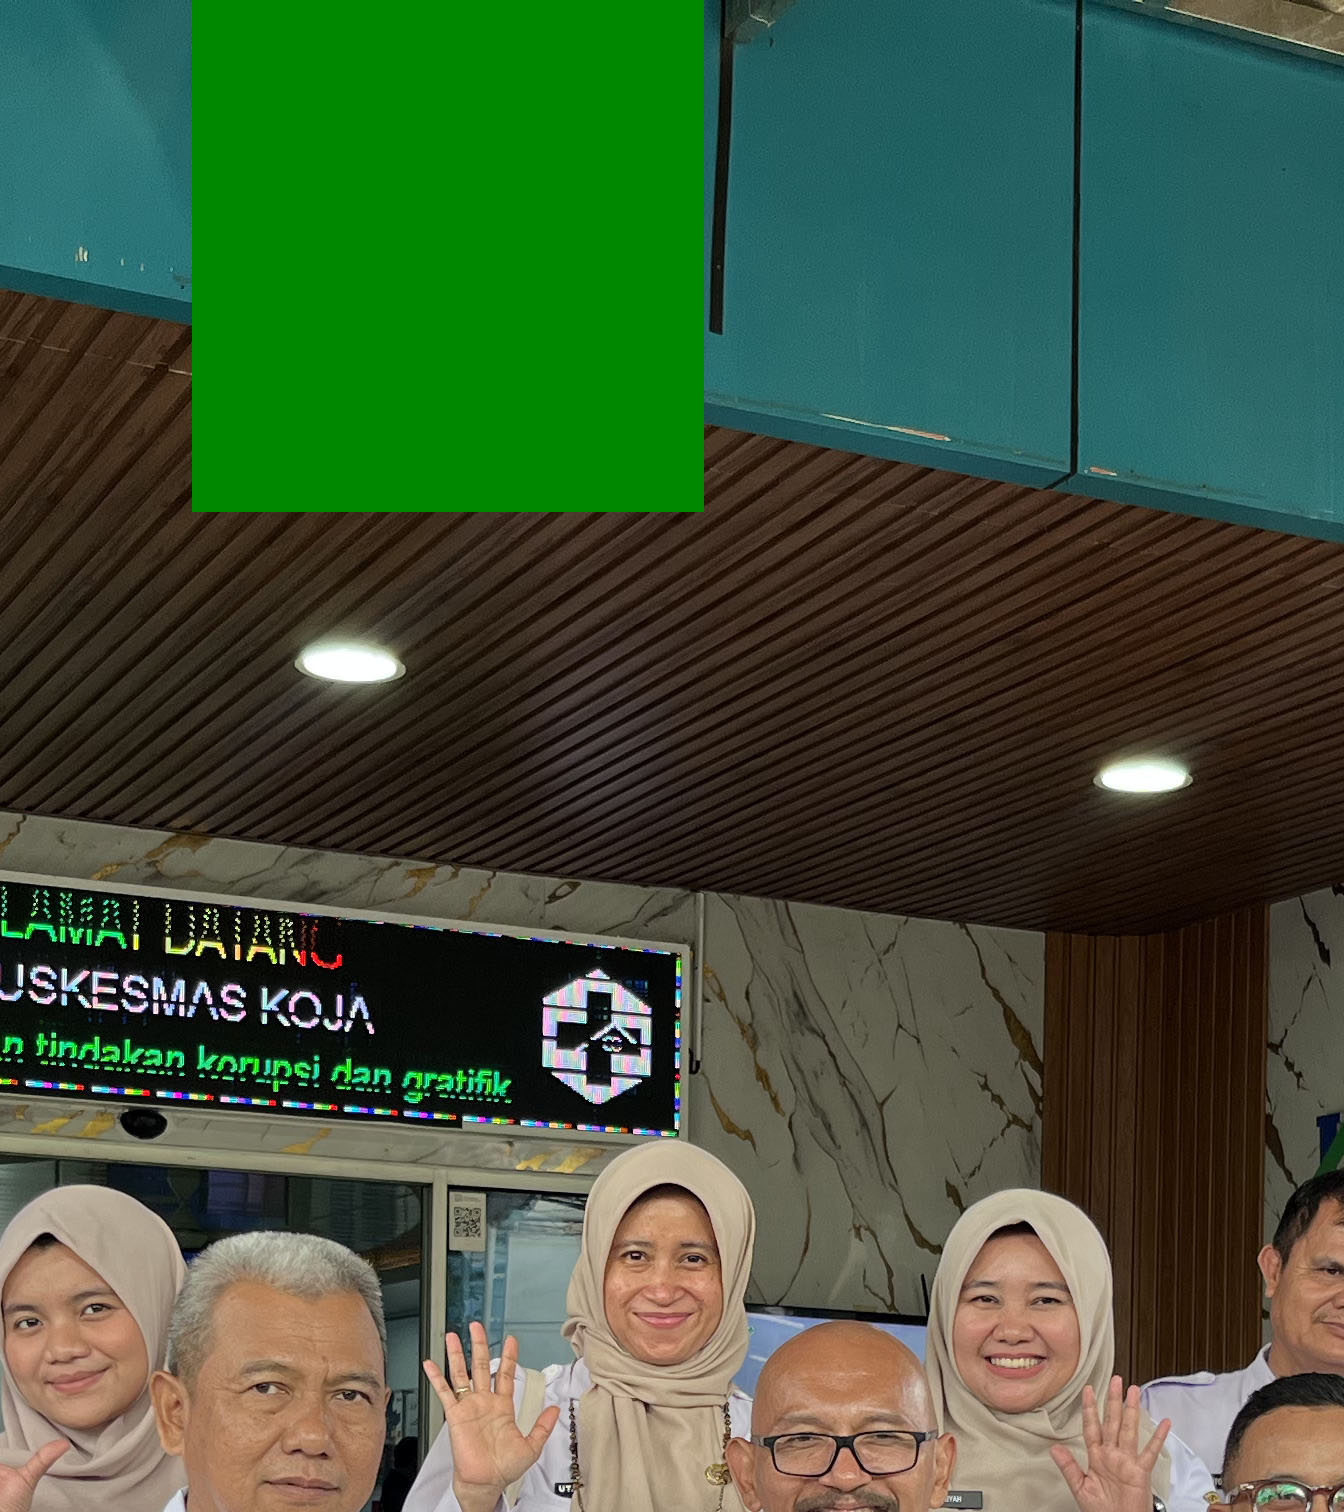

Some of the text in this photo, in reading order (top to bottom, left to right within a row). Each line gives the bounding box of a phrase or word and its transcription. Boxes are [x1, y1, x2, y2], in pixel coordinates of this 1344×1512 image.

[164, 901, 343, 969] DATANG
[262, 986, 375, 1034] KOJA
[36, 1031, 185, 1077] tindakan
[197, 1044, 320, 1092] korupsi
[332, 1058, 391, 1093] dan
[558, 1484, 573, 1493] UT
